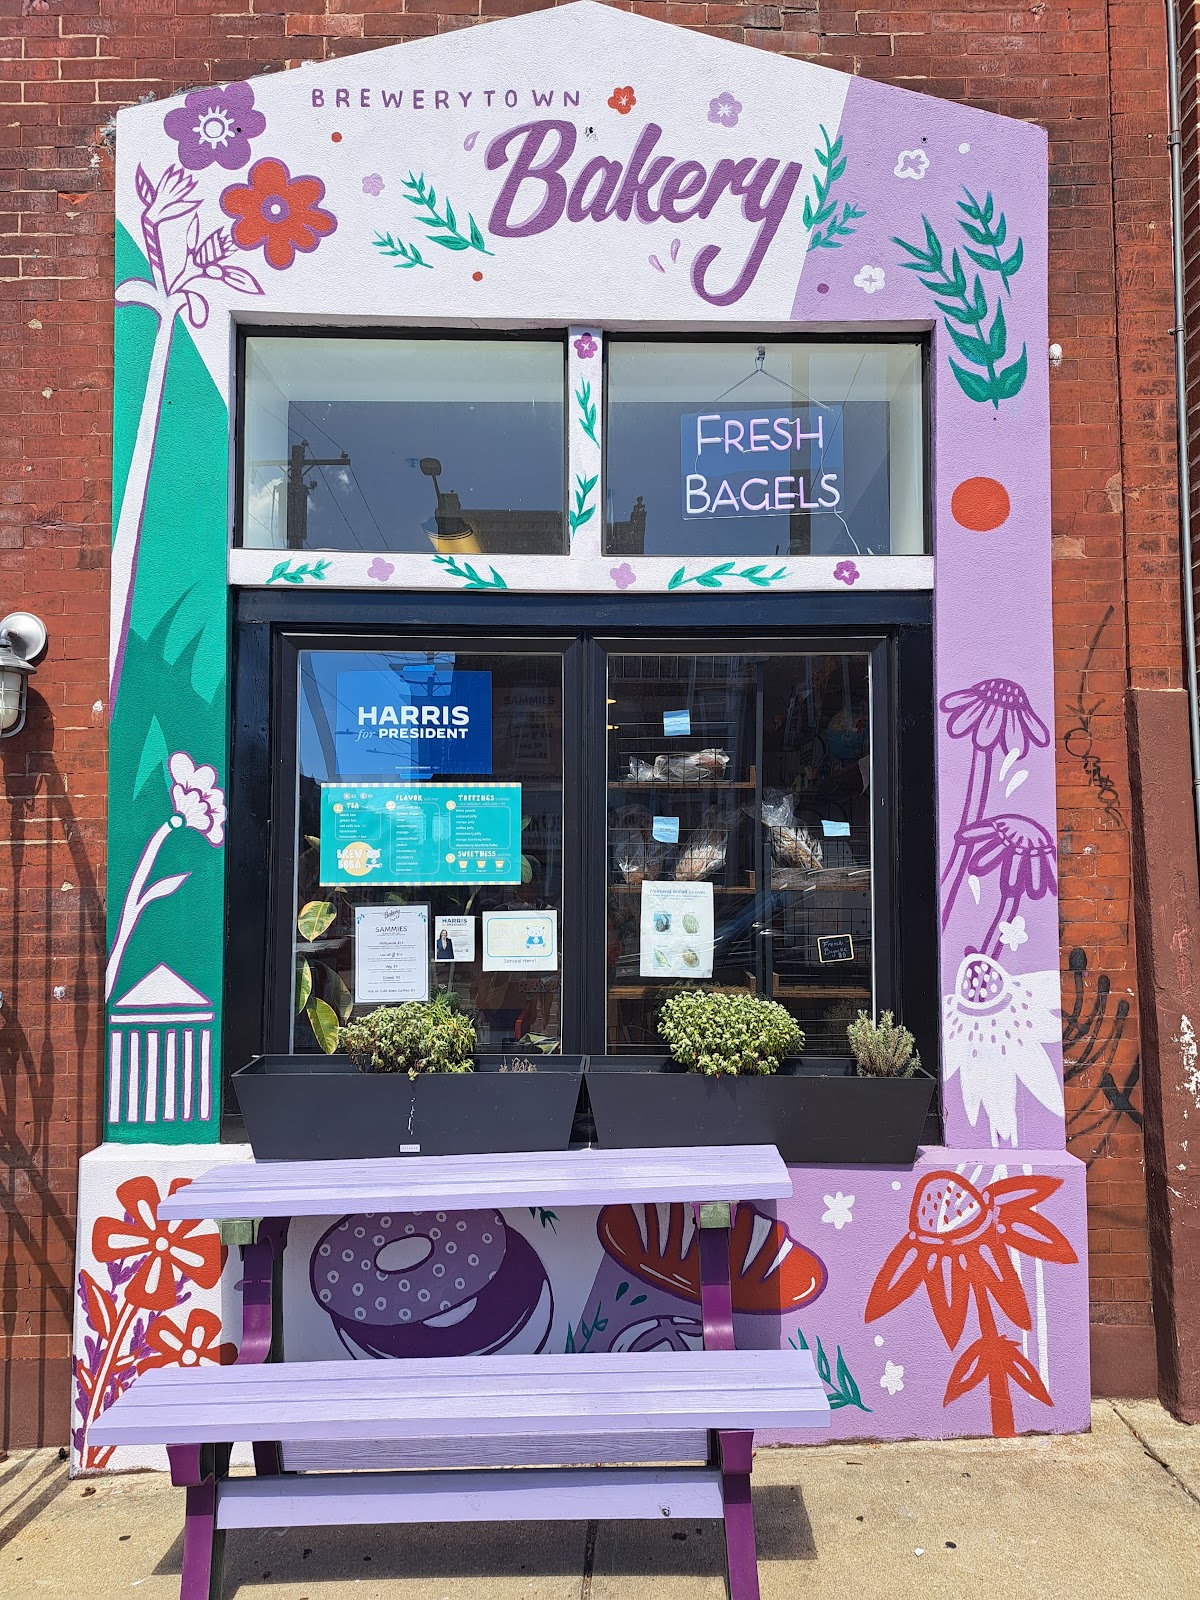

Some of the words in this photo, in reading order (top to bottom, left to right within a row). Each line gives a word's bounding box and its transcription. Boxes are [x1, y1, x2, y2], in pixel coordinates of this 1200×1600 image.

[311, 88, 580, 110] BREWERYTOWN
[484, 119, 802, 307] Bakery
[697, 414, 823, 455] FRESH
[686, 473, 841, 514] BAGELS
[504, 696, 555, 704] SAMMIES
[358, 705, 470, 726] HARRIS
[355, 728, 376, 742] for
[378, 728, 469, 739] PRESIDENT
[337, 849, 363, 859] BREW
[338, 859, 361, 869] BOBA
